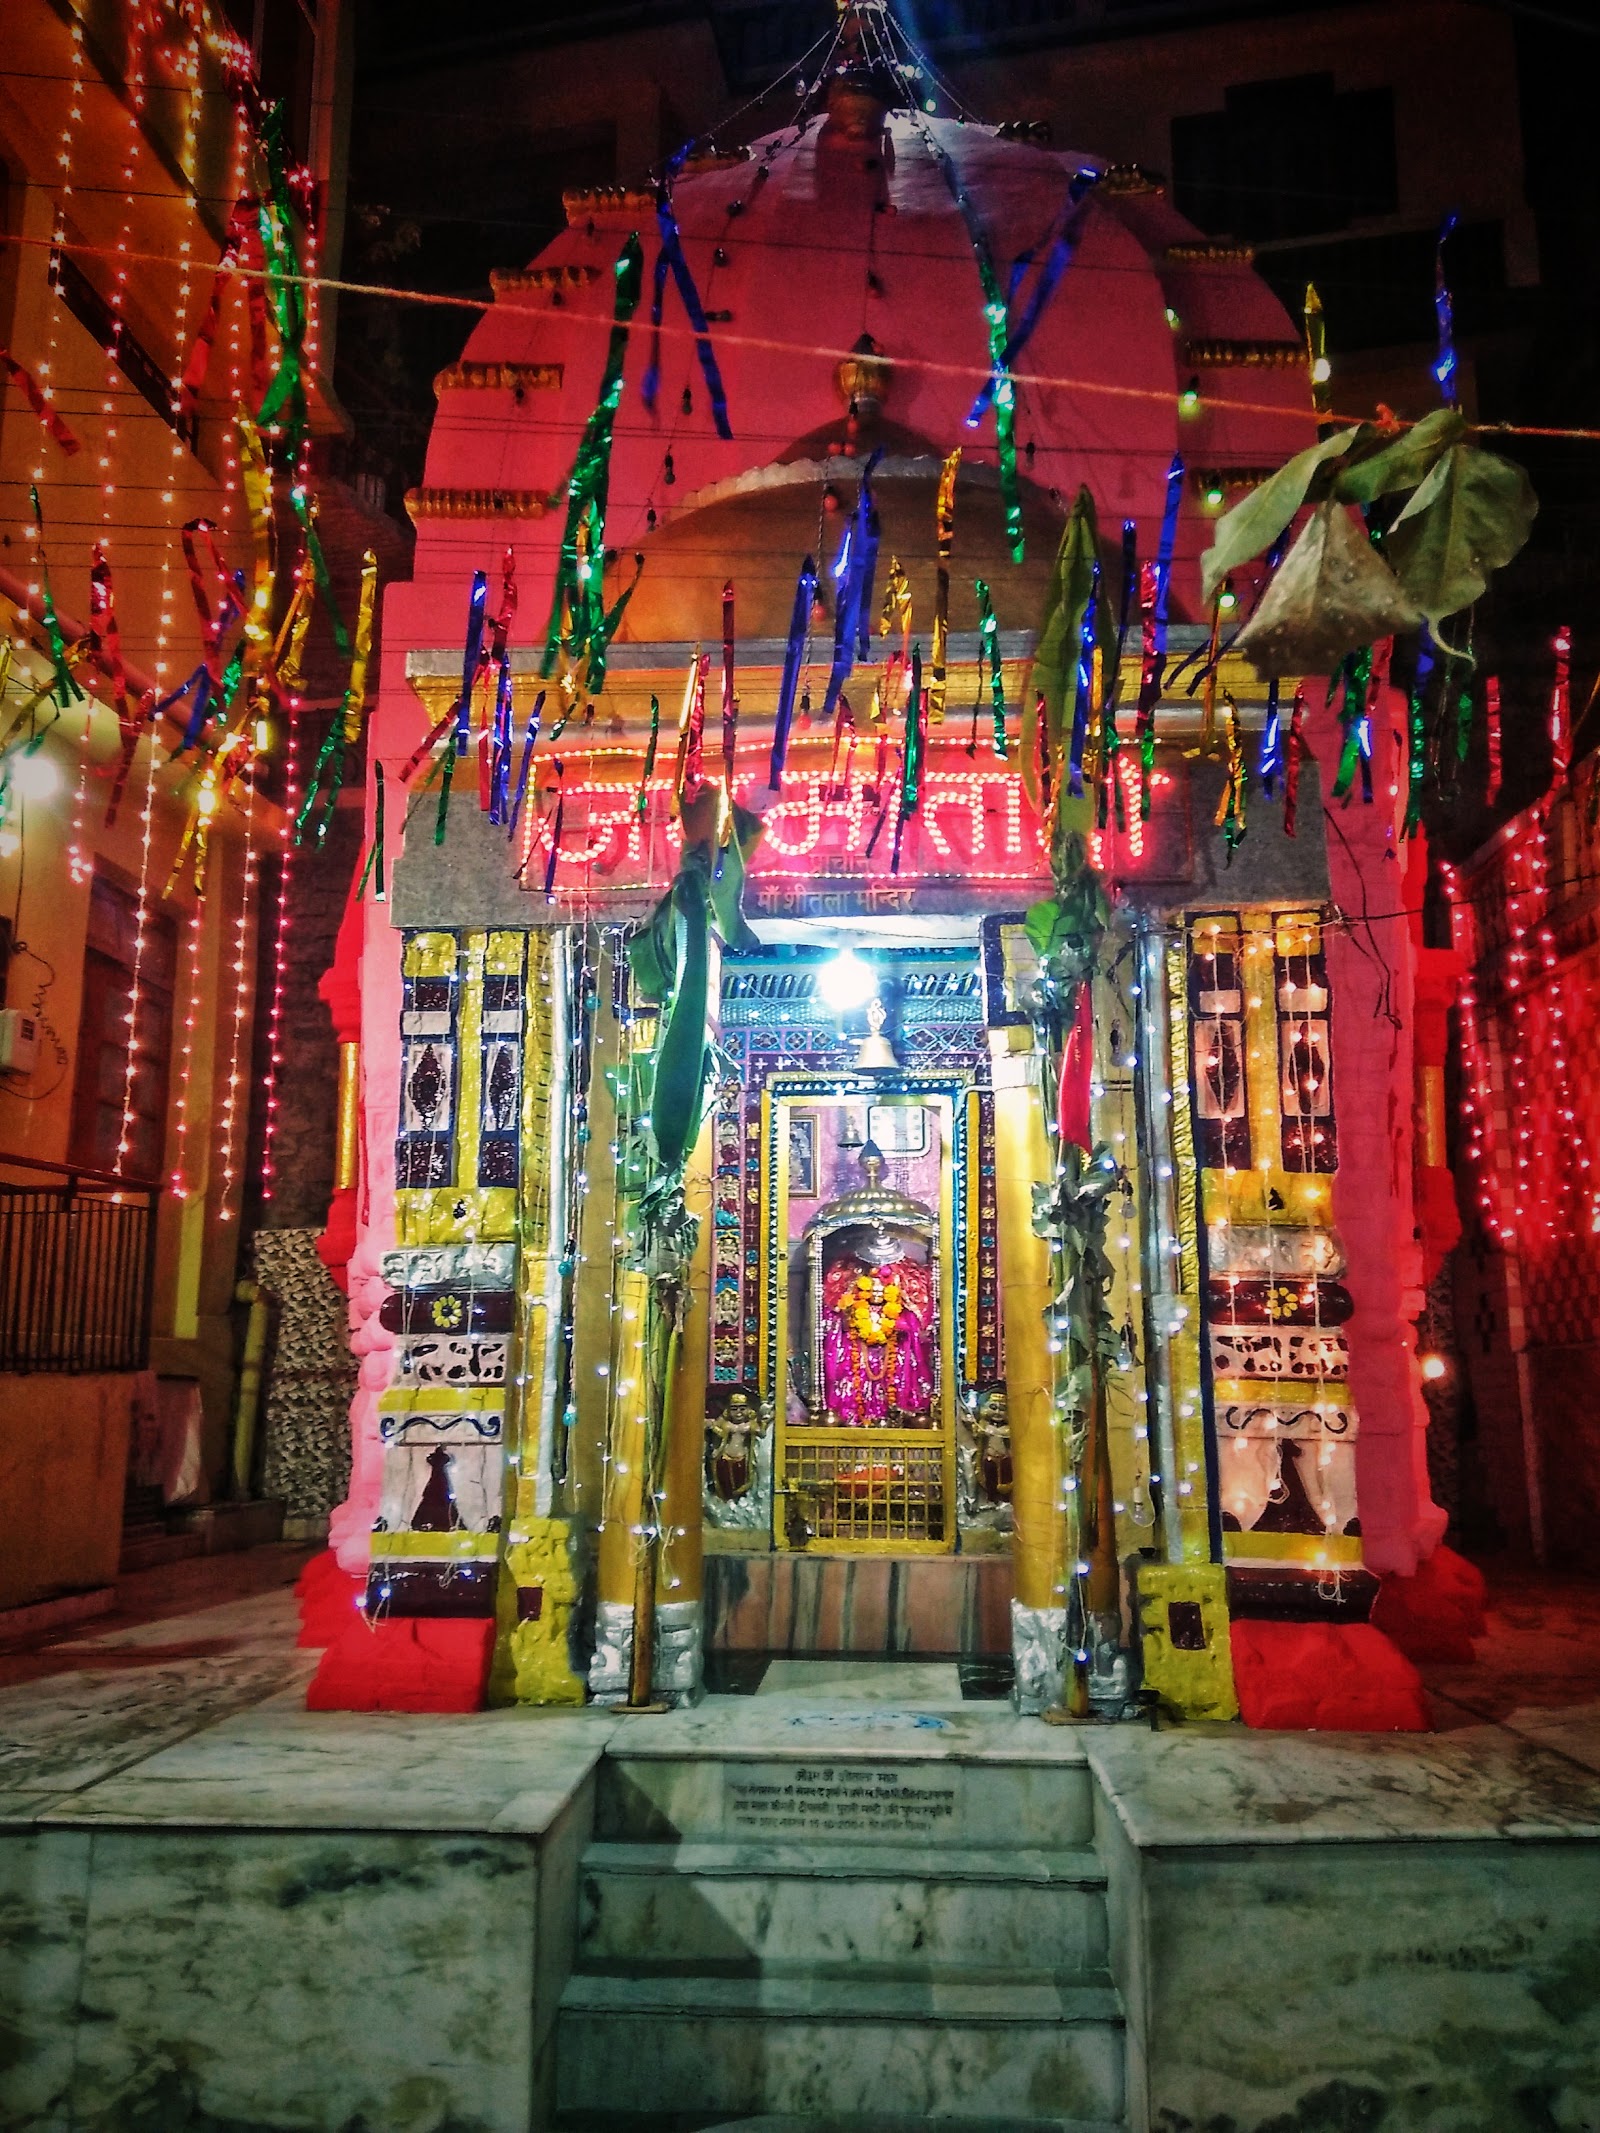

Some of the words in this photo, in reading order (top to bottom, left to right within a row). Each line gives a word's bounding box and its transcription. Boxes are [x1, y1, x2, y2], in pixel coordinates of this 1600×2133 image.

[762, 770, 1021, 856] माता
[782, 883, 851, 914] शीतला
[853, 883, 916, 913] मन्दिर
